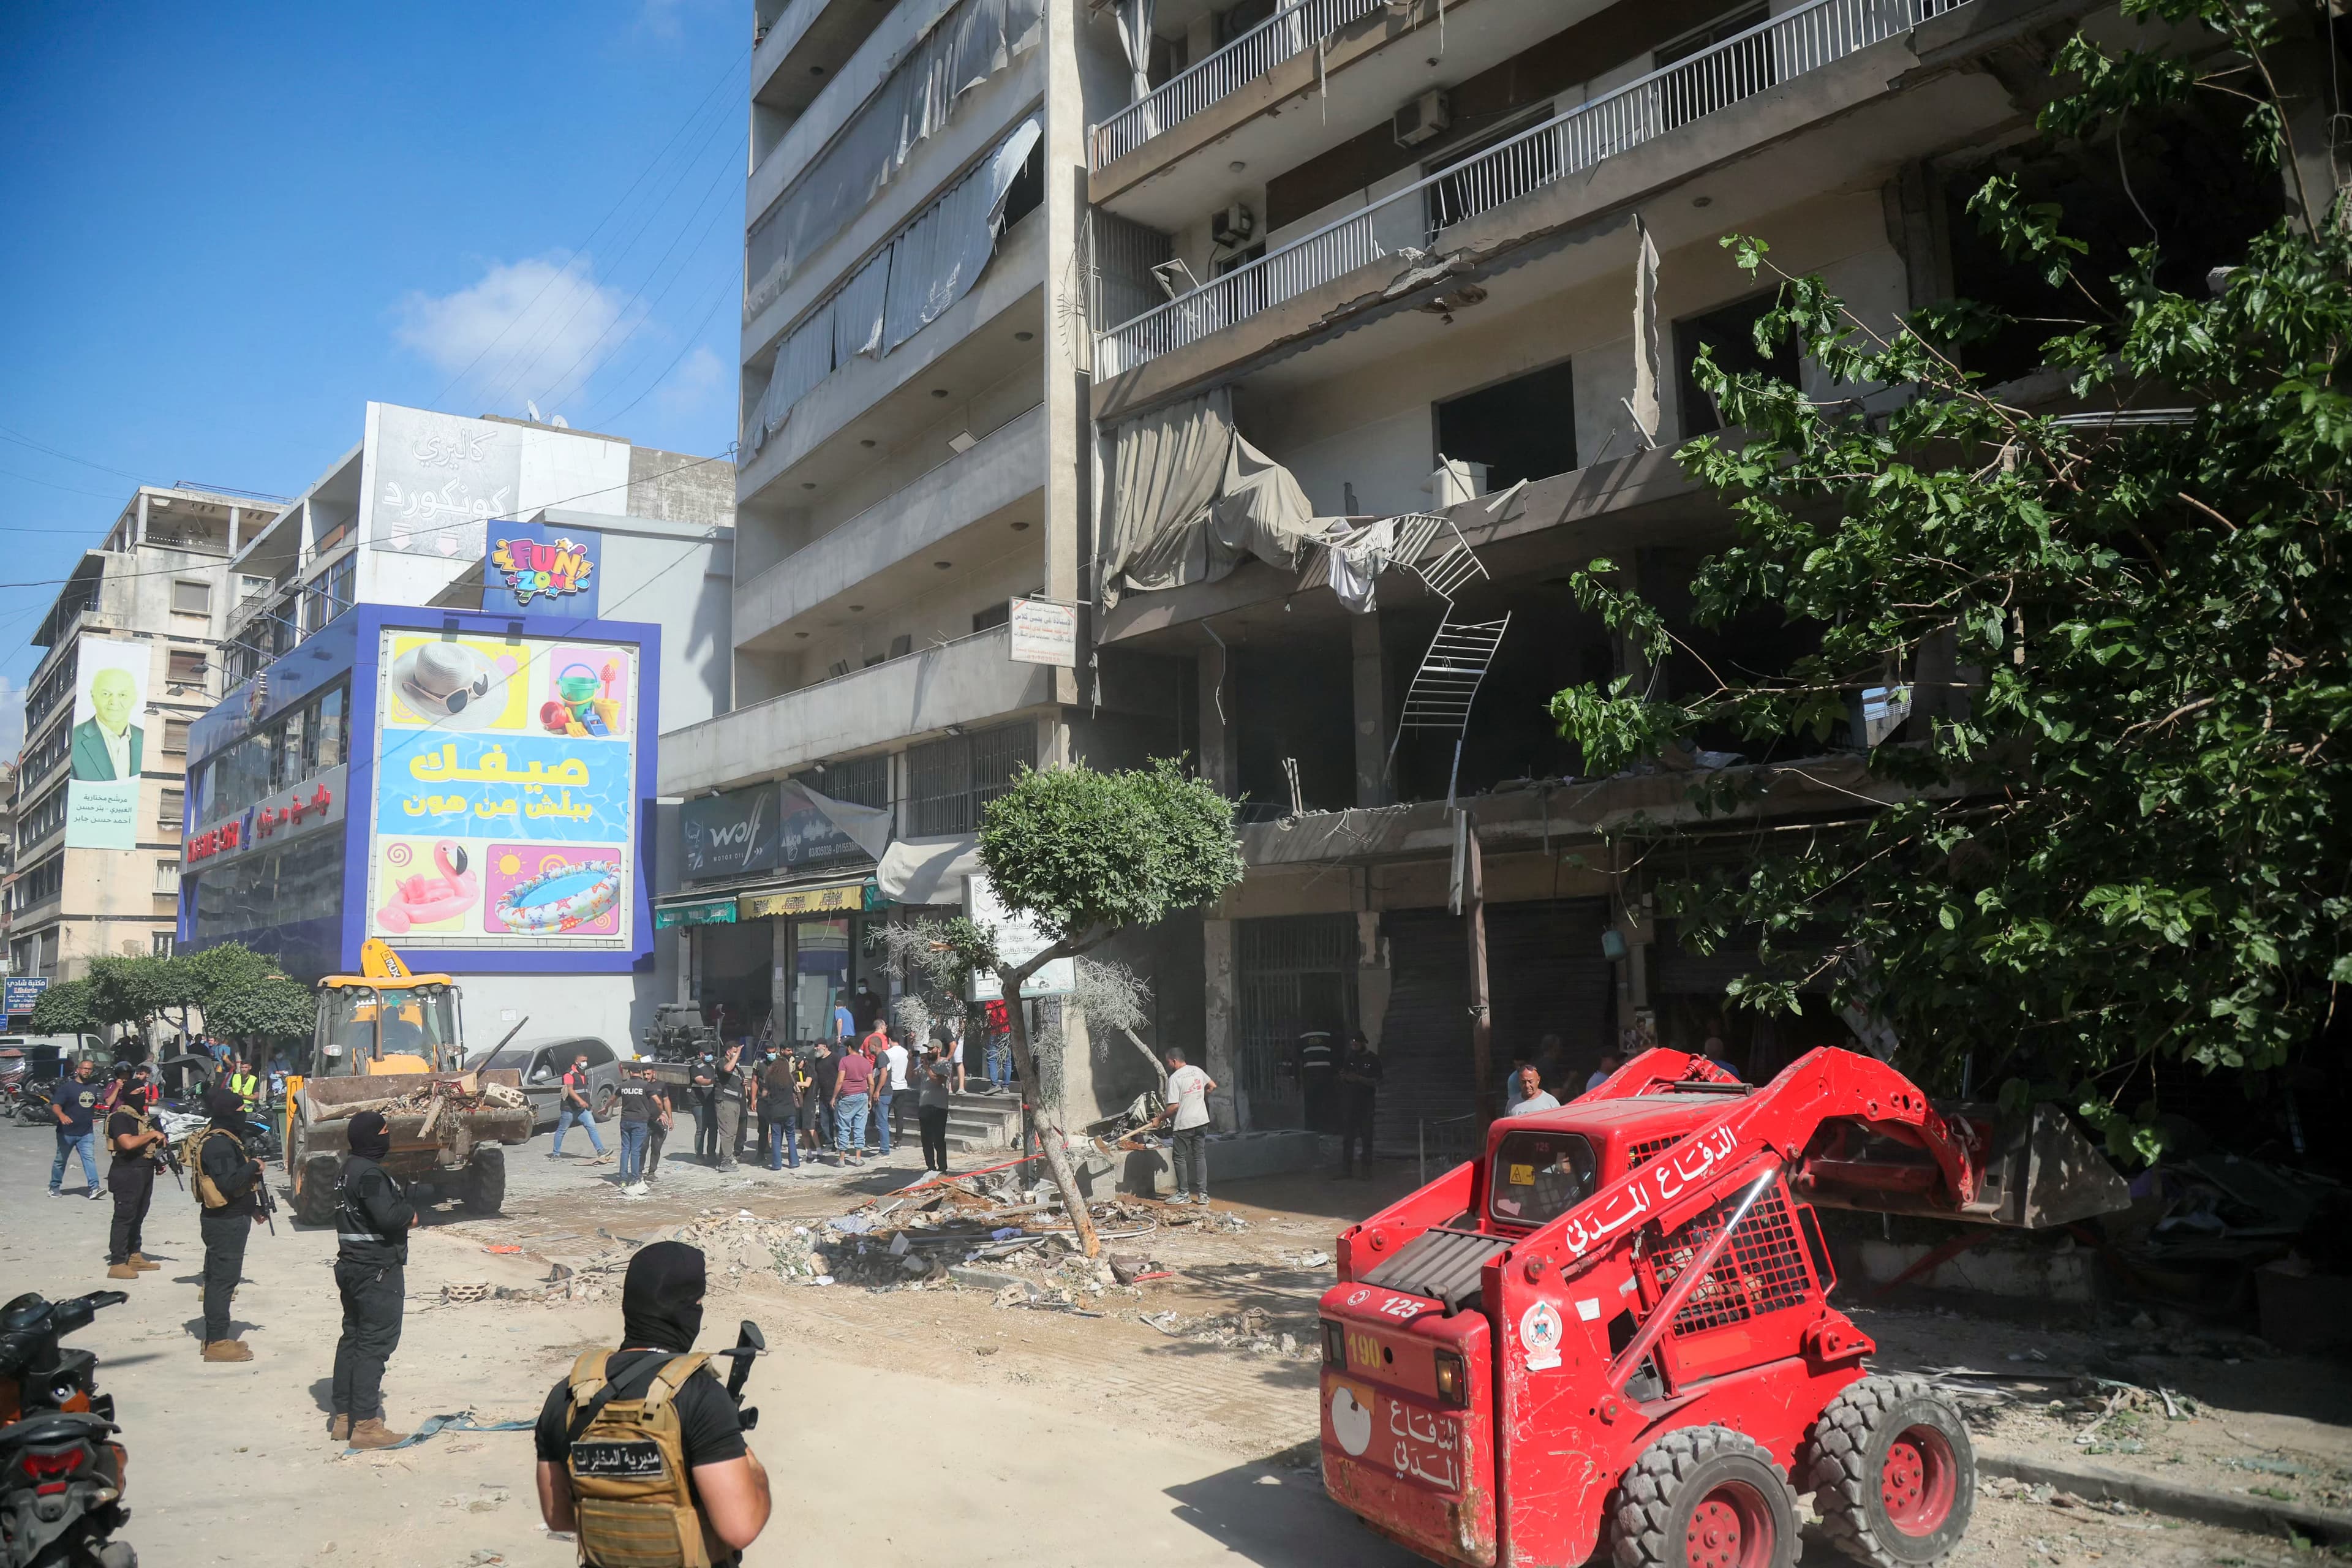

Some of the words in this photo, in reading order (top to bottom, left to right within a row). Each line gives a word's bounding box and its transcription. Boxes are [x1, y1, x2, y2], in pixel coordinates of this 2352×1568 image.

[412, 428, 497, 469] كاليري
[383, 477, 510, 526] كونكورد
[516, 570, 576, 591] ZONE
[409, 743, 589, 793] صيفك
[108, 794, 127, 803] مرشح
[402, 794, 467, 816] هون
[473, 797, 518, 818] من
[90, 815, 111, 824] حسن
[7, 979, 27, 988] شادي
[1380, 1297, 1425, 1317] 125
[1349, 1332, 1381, 1369] 190
[576, 1449, 621, 1471] المخابرات
[620, 1447, 660, 1470] مديرية
